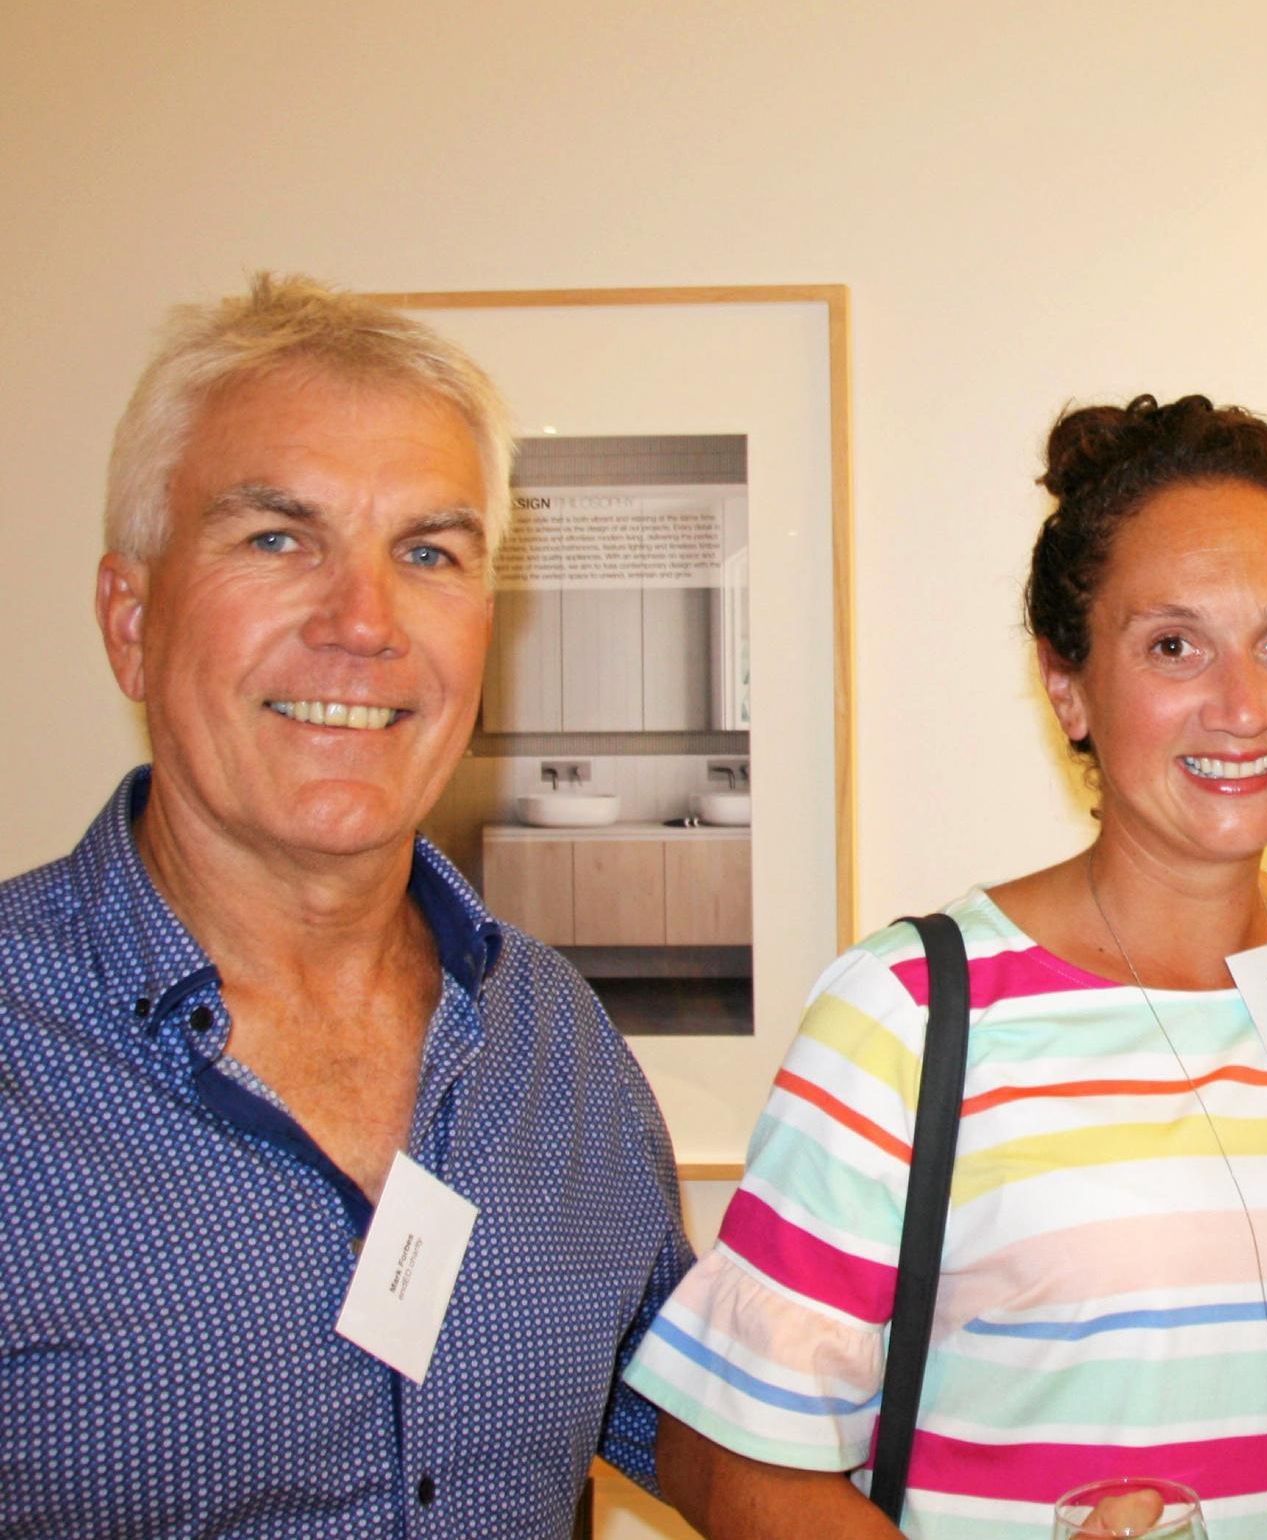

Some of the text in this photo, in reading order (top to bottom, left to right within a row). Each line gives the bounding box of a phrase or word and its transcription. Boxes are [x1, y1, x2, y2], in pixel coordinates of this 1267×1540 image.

[513, 497, 551, 510] SIGN
[390, 1234, 413, 1293] Mark Forbes
